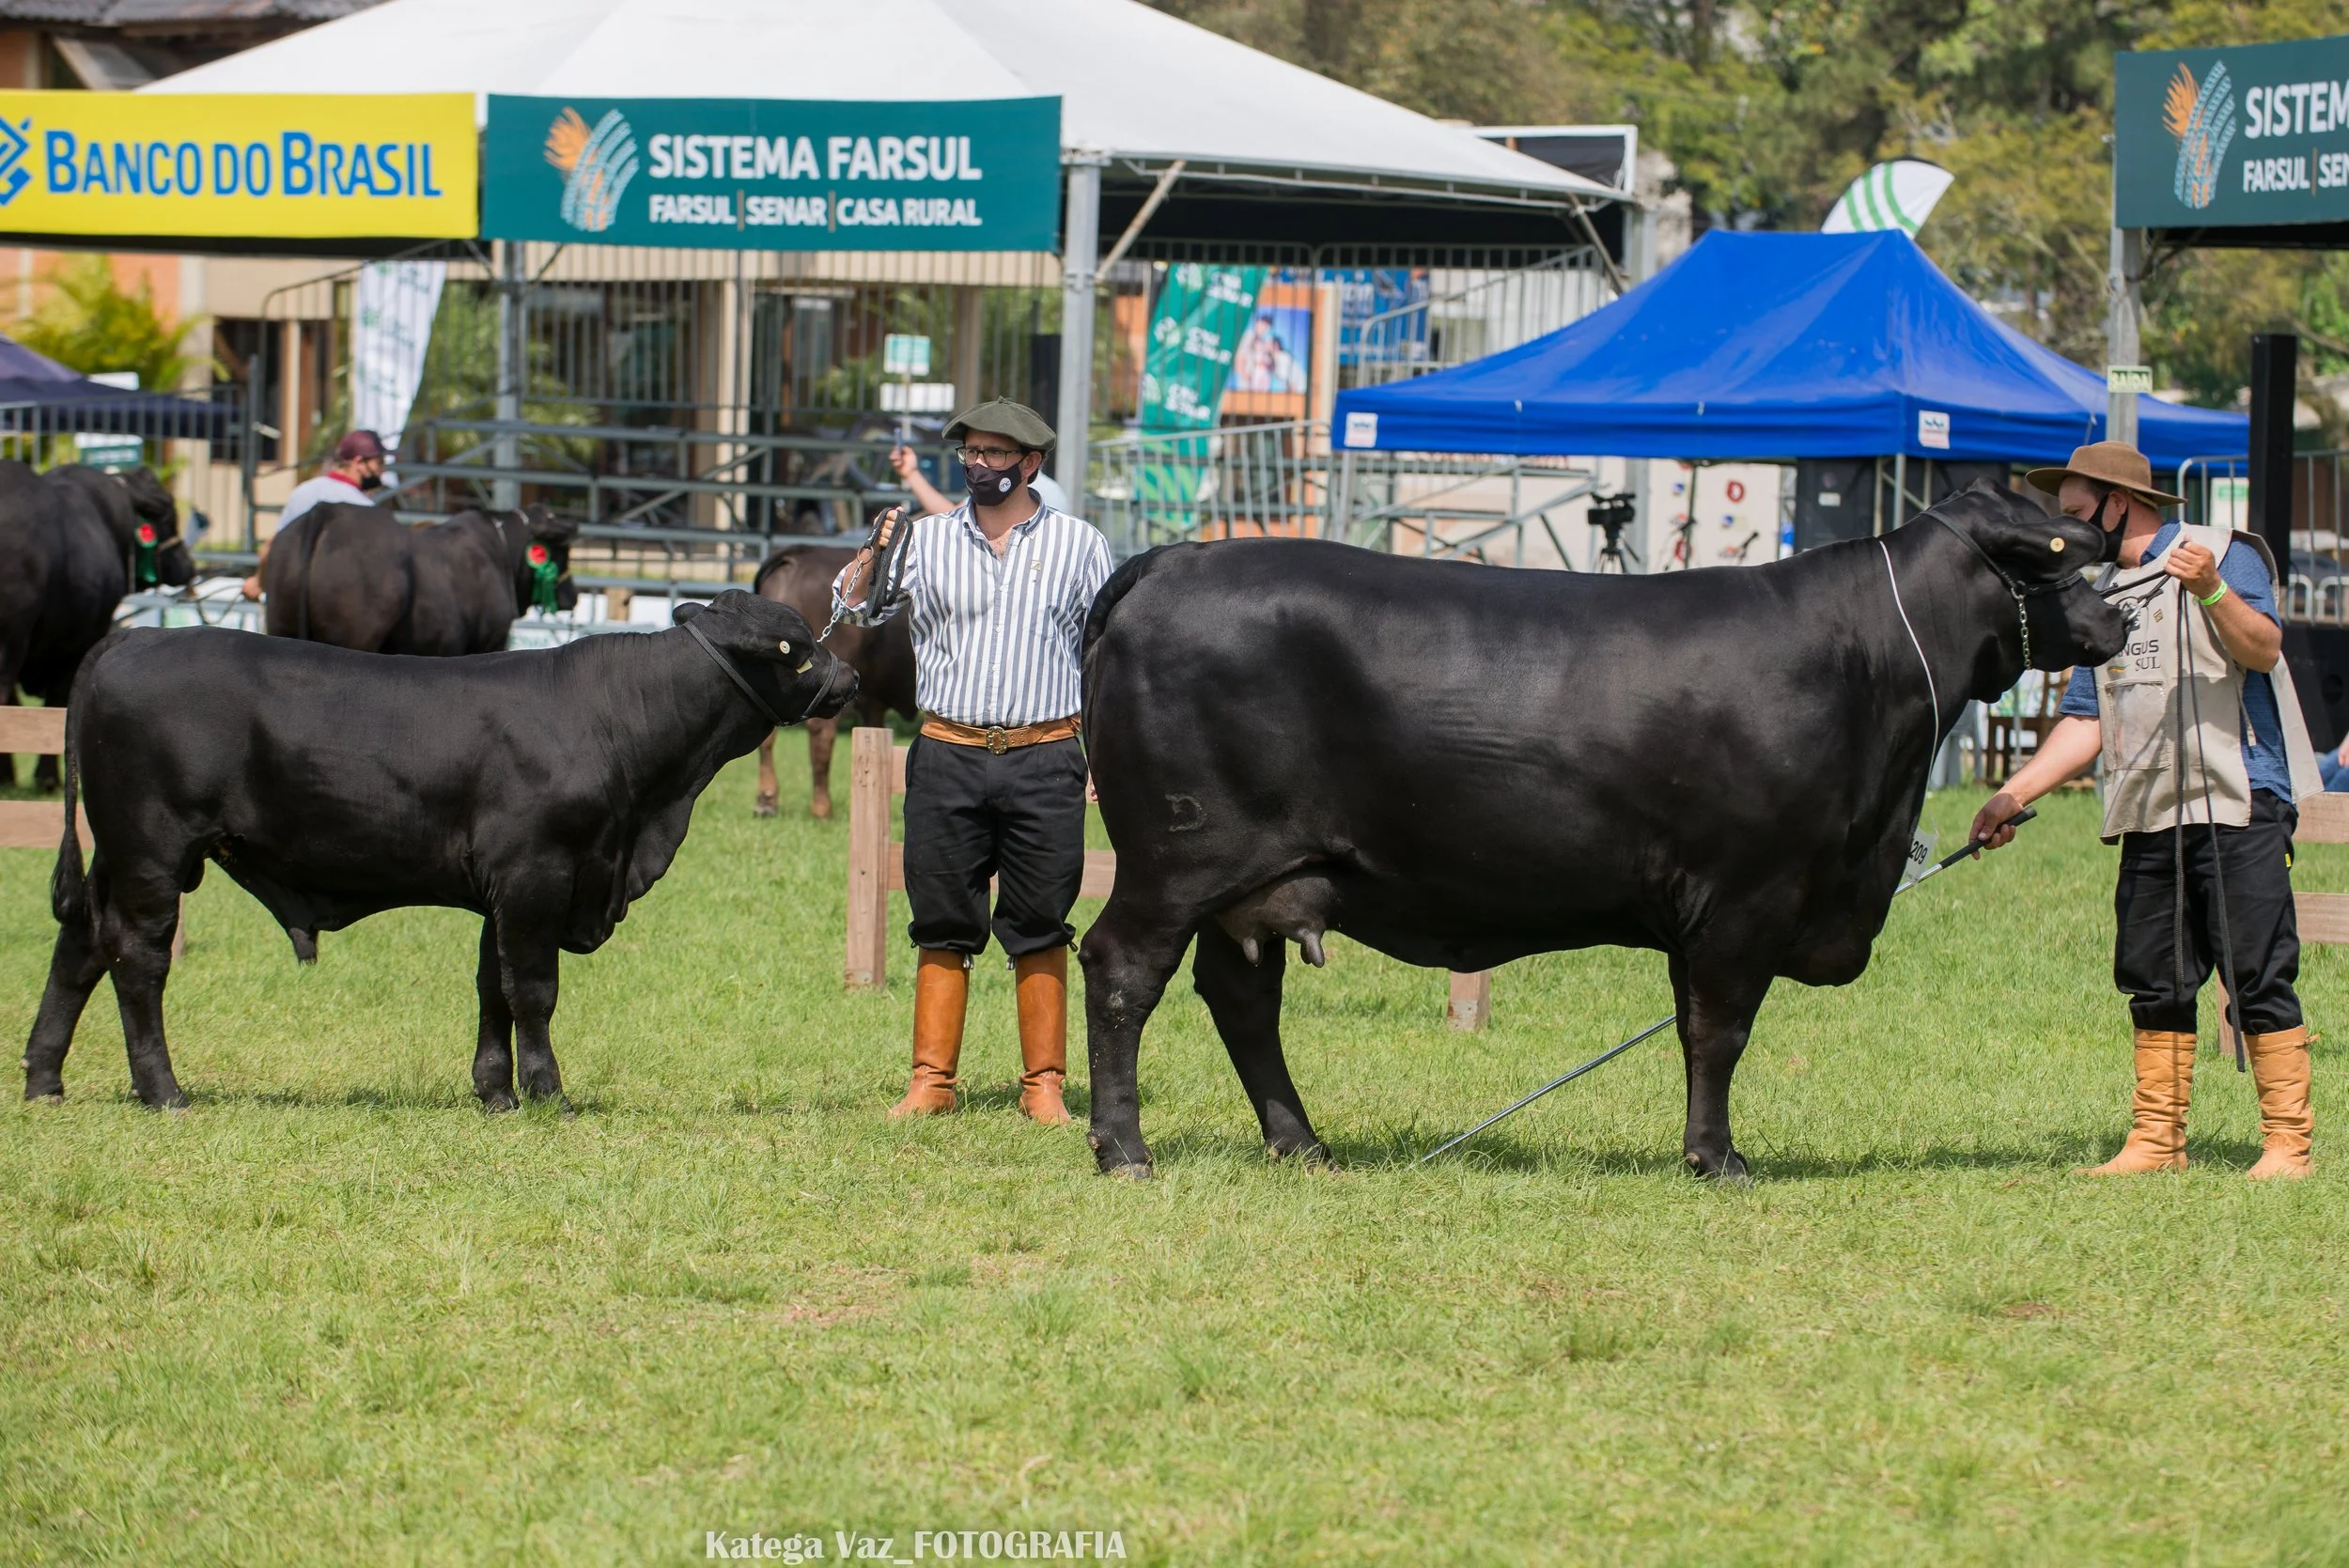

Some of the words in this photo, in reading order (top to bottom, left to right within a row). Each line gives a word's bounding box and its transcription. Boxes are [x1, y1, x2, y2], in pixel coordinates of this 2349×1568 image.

[44, 130, 204, 195] BANCO
[212, 141, 272, 196] DO
[281, 131, 443, 197] BRASIL
[648, 133, 820, 180] SISTEMA
[827, 134, 983, 181] FARSUL
[2242, 155, 2311, 193] FARSUL
[648, 194, 737, 225] FARSUL
[745, 195, 828, 226] SENAR
[835, 195, 900, 227] CASA
[903, 196, 983, 228] RURAL
[2135, 656, 2162, 672] SUL
[1907, 840, 1929, 865] 209
